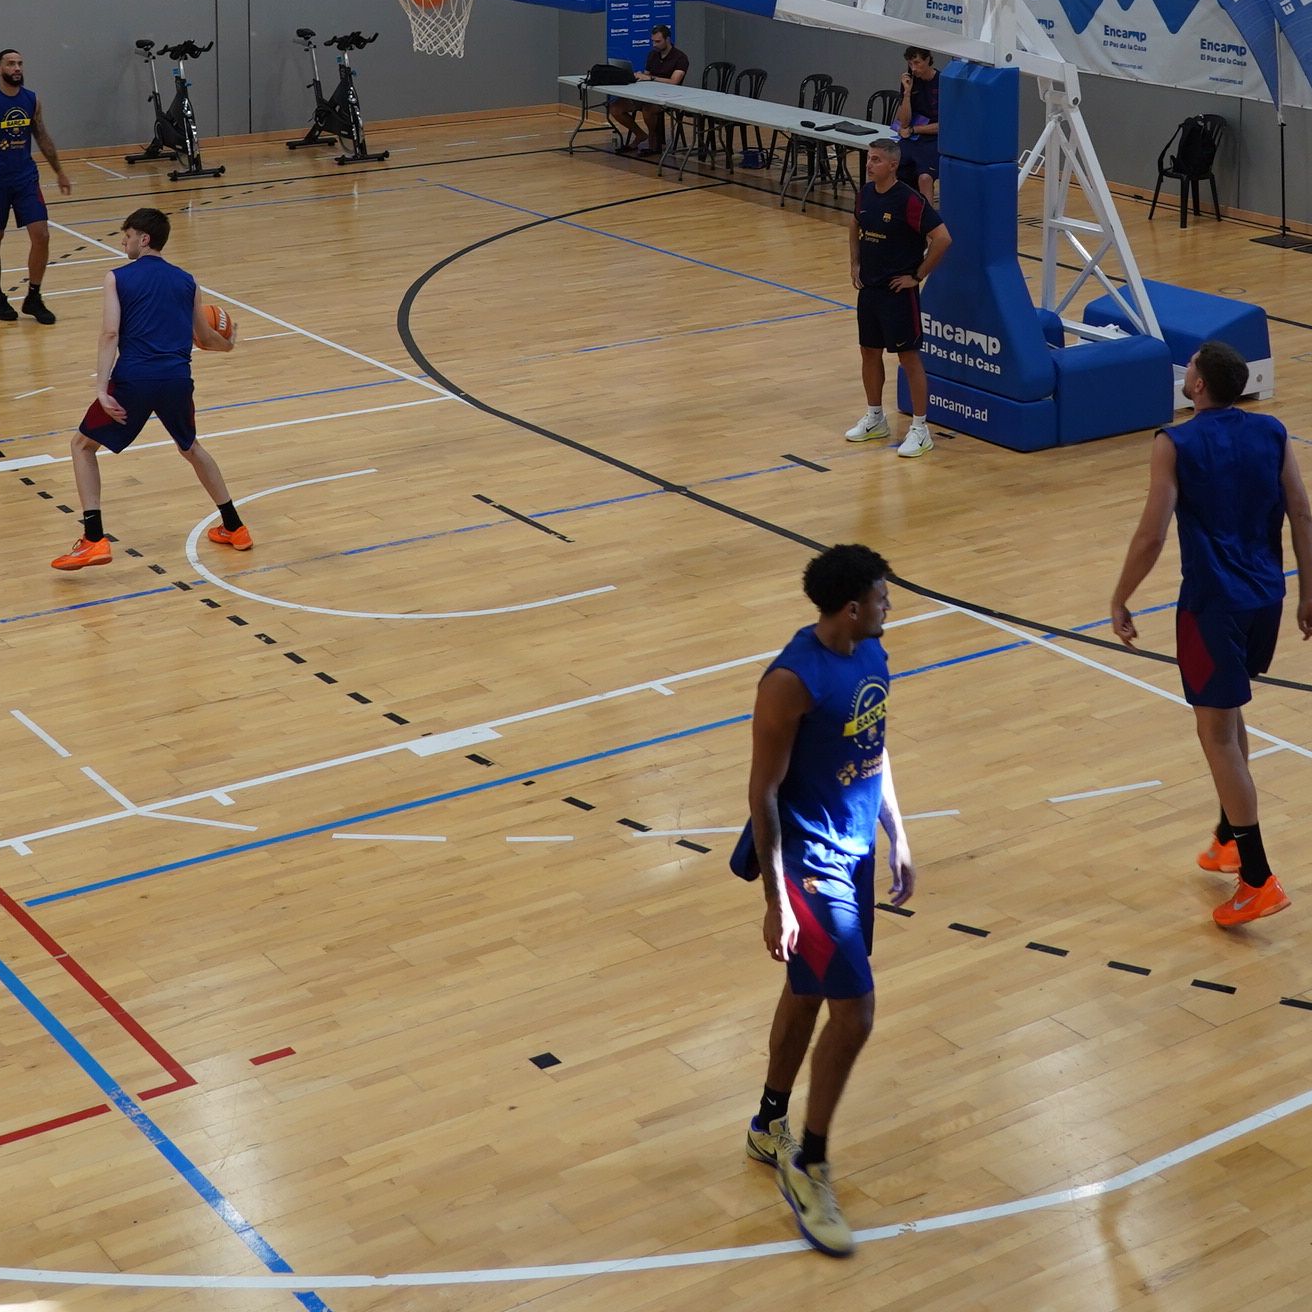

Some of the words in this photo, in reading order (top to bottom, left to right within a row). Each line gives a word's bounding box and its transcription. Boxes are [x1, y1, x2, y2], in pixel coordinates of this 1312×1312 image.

[926, 0, 962, 15] Encamp
[1104, 25, 1146, 42] Encamp
[1201, 38, 1246, 56] Encamp
[921, 312, 1001, 356] Encamp
[931, 344, 947, 359] Pas
[950, 351, 962, 363] de
[965, 354, 973, 366] la
[976, 359, 1000, 374] Casa
[930, 394, 988, 422] encamp.ad
